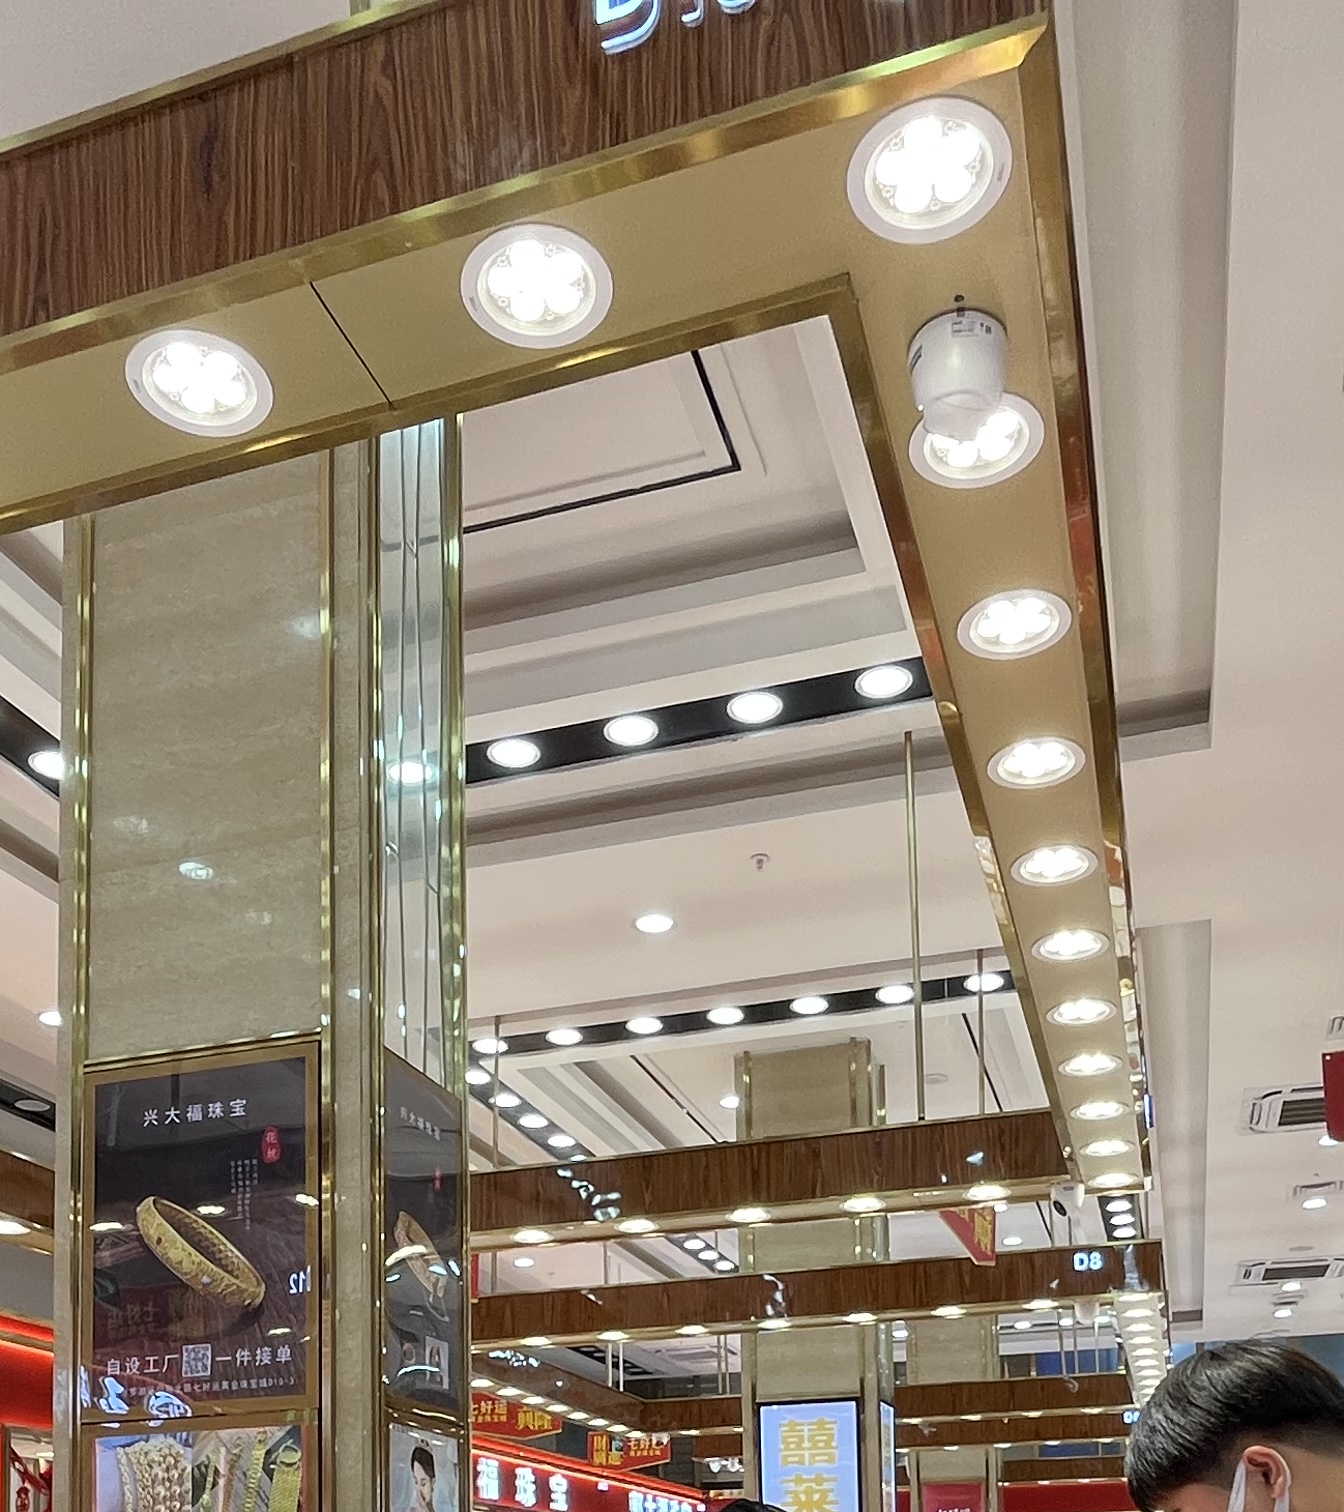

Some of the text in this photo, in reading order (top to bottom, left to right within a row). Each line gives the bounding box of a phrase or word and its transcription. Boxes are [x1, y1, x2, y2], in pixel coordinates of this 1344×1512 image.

[143, 1098, 247, 1127] 兴大福珠宝
[1073, 1252, 1103, 1271] D8
[107, 1345, 293, 1376] 自设工厂 一件接单
